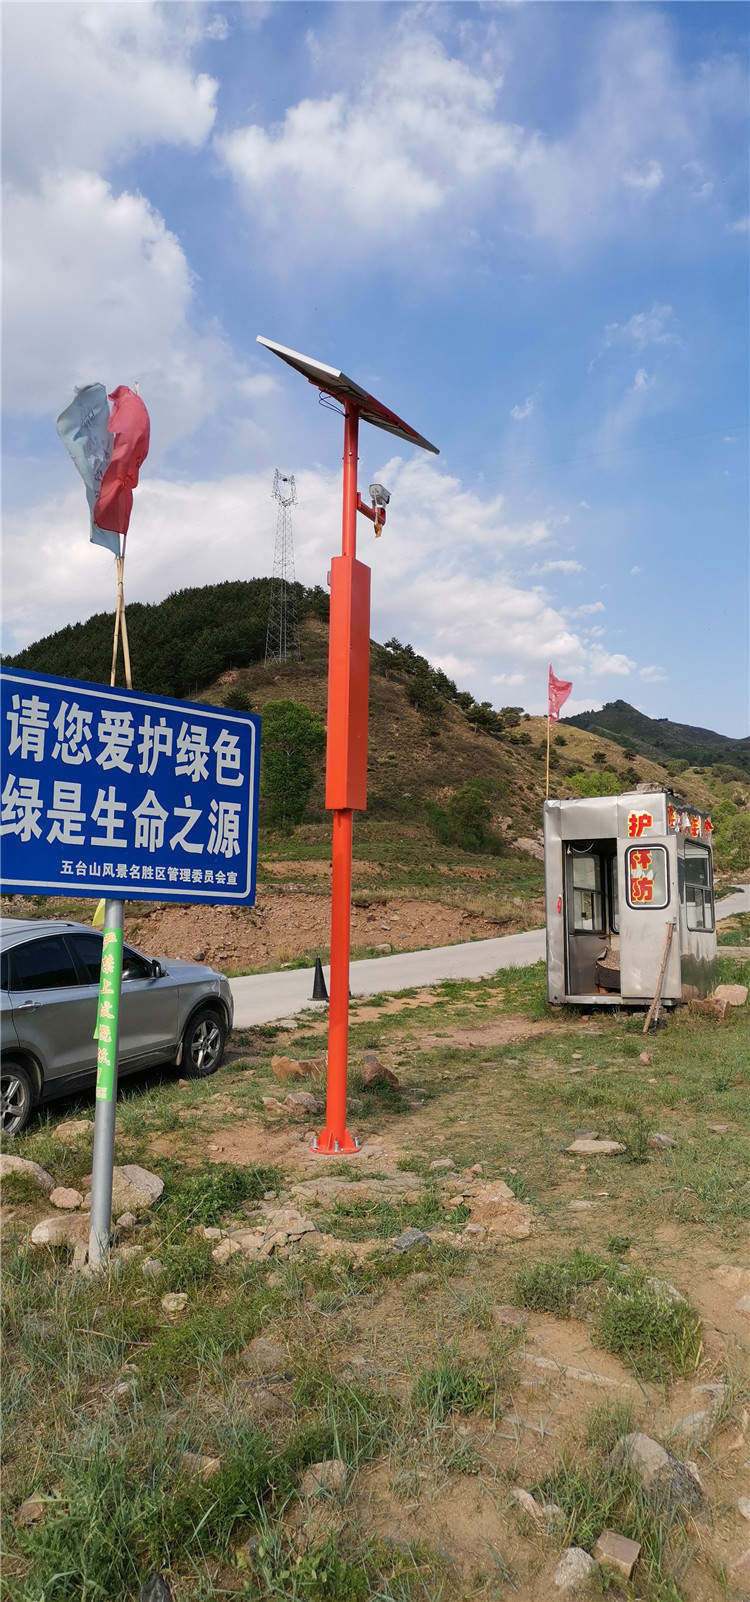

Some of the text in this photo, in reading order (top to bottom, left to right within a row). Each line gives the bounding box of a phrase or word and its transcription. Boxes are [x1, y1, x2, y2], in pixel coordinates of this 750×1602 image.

[6, 693, 245, 787] 请您爱护绿色
[0, 773, 242, 858] 绿是生命之源
[60, 859, 238, 885] 五台山风景名胜区管理委员会宣
